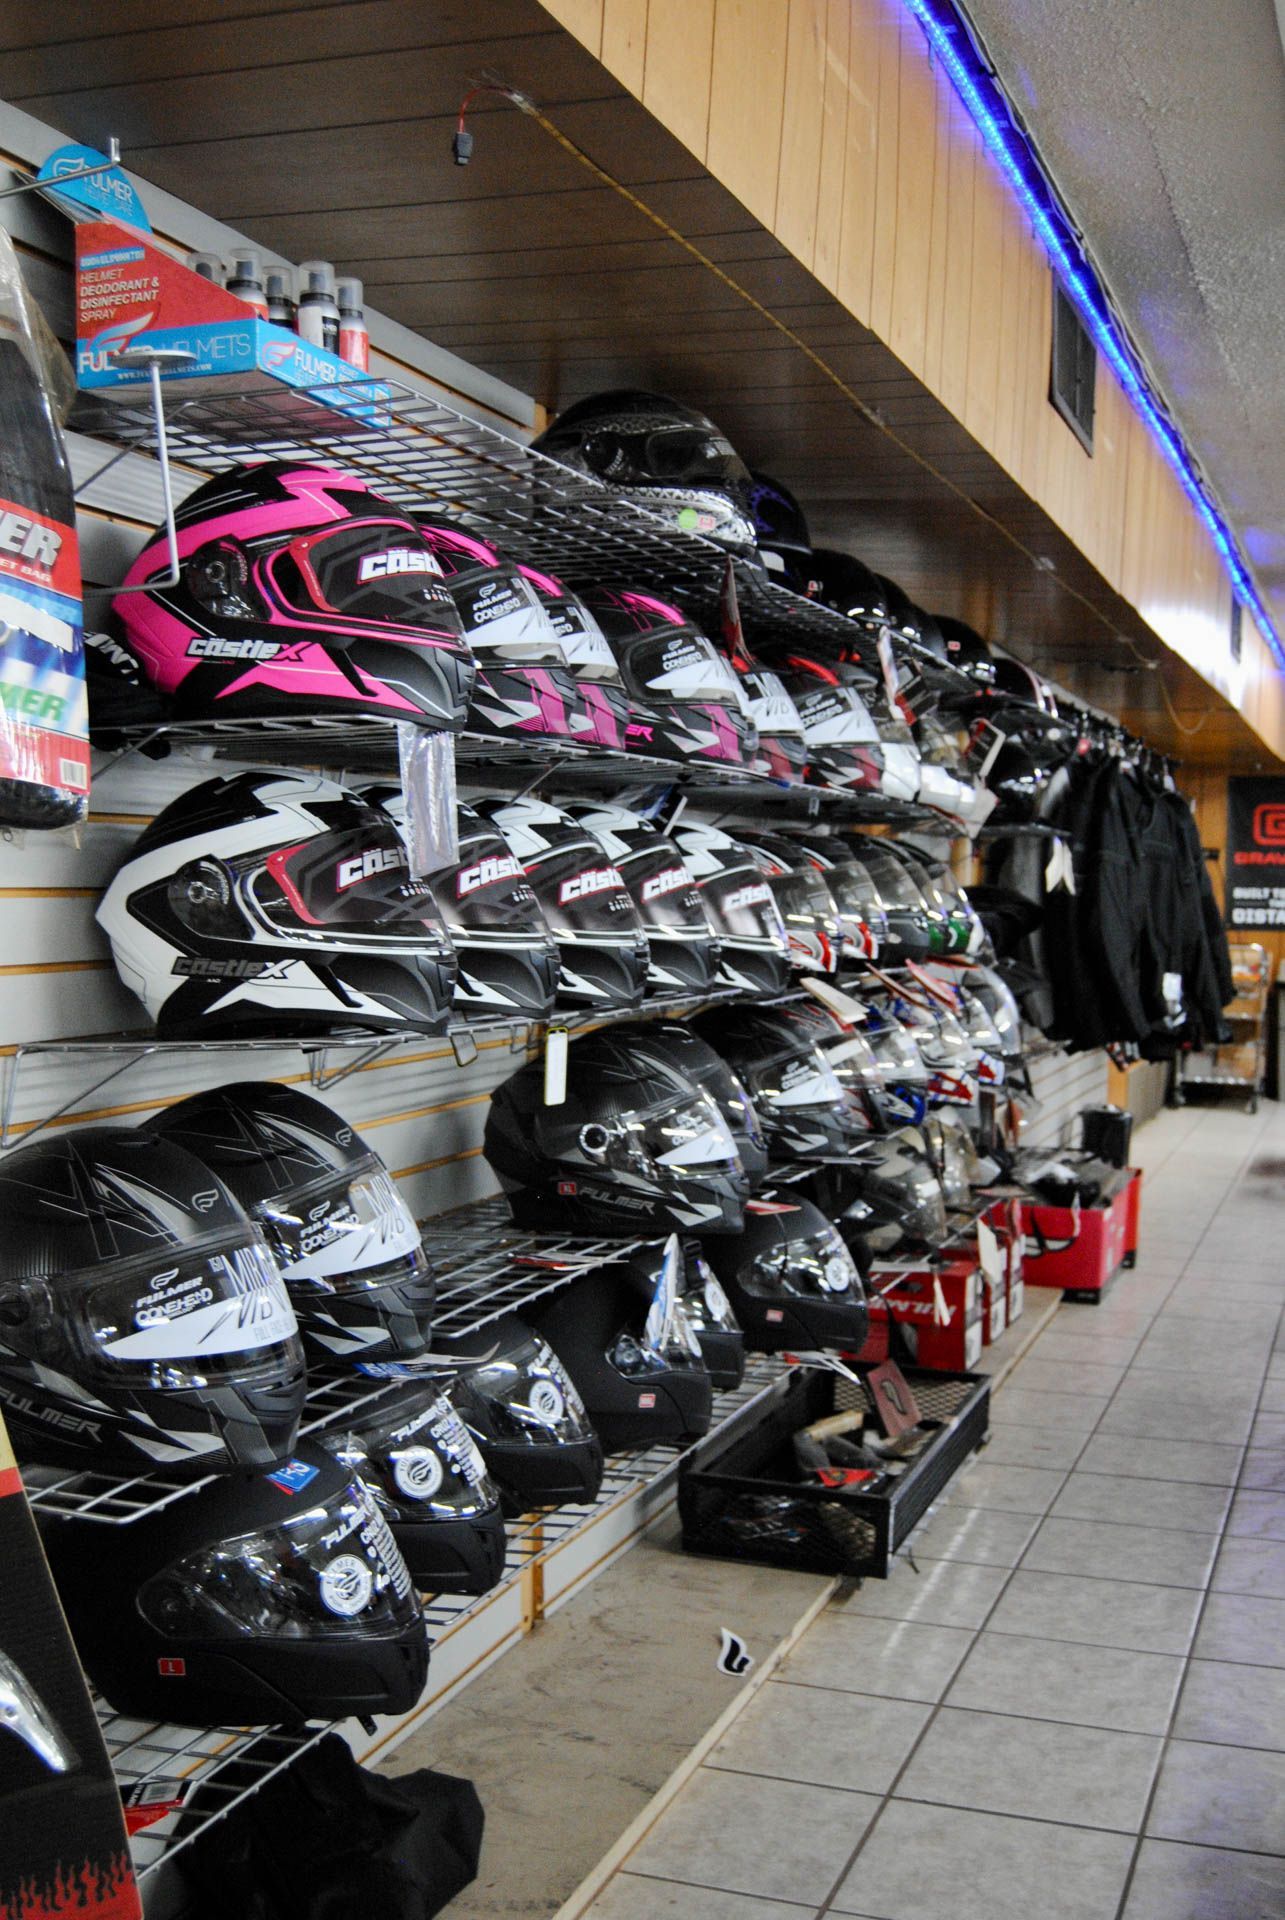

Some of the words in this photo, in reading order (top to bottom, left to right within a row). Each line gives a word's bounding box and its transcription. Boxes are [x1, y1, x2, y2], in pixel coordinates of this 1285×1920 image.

[80, 269, 124, 283] HELMET
[80, 278, 150, 297] DEODORANT
[152, 276, 160, 287] &
[80, 291, 159, 310] DISINFECTANT
[80, 308, 117, 323] SPRAY
[79, 346, 154, 374] FUL
[161, 334, 250, 360] METS
[0, 512, 62, 567] ER
[21, 567, 52, 583] BAG
[135, 1276, 204, 1308] FULMER
